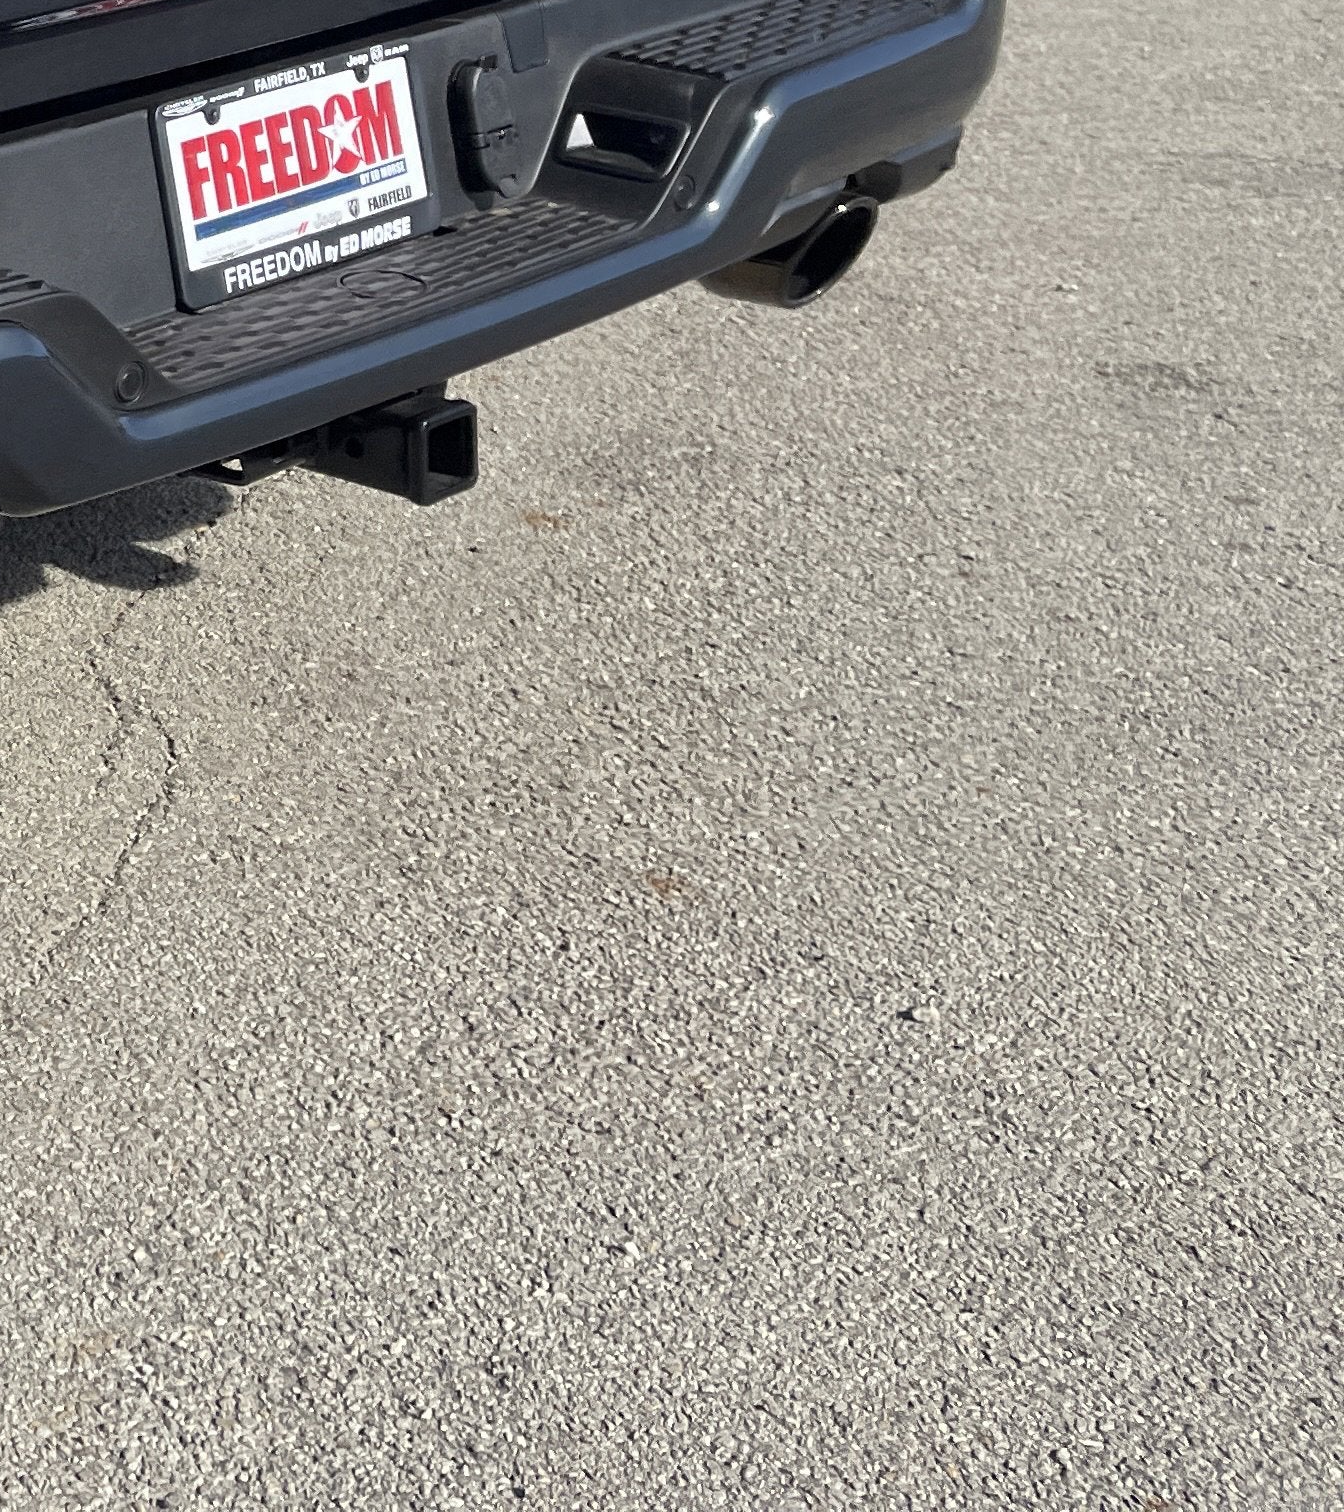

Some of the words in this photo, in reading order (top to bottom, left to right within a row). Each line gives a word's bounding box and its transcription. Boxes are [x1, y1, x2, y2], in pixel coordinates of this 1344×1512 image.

[254, 66, 310, 93] FAIRFIELD,
[310, 61, 326, 77] TX
[346, 53, 369, 68] Jeep
[180, 80, 404, 221] FREEDOM
[368, 185, 412, 212] FAIRFIELD
[223, 239, 322, 294] FREEDOM
[339, 233, 360, 257] ED
[360, 215, 411, 251] MORSE
